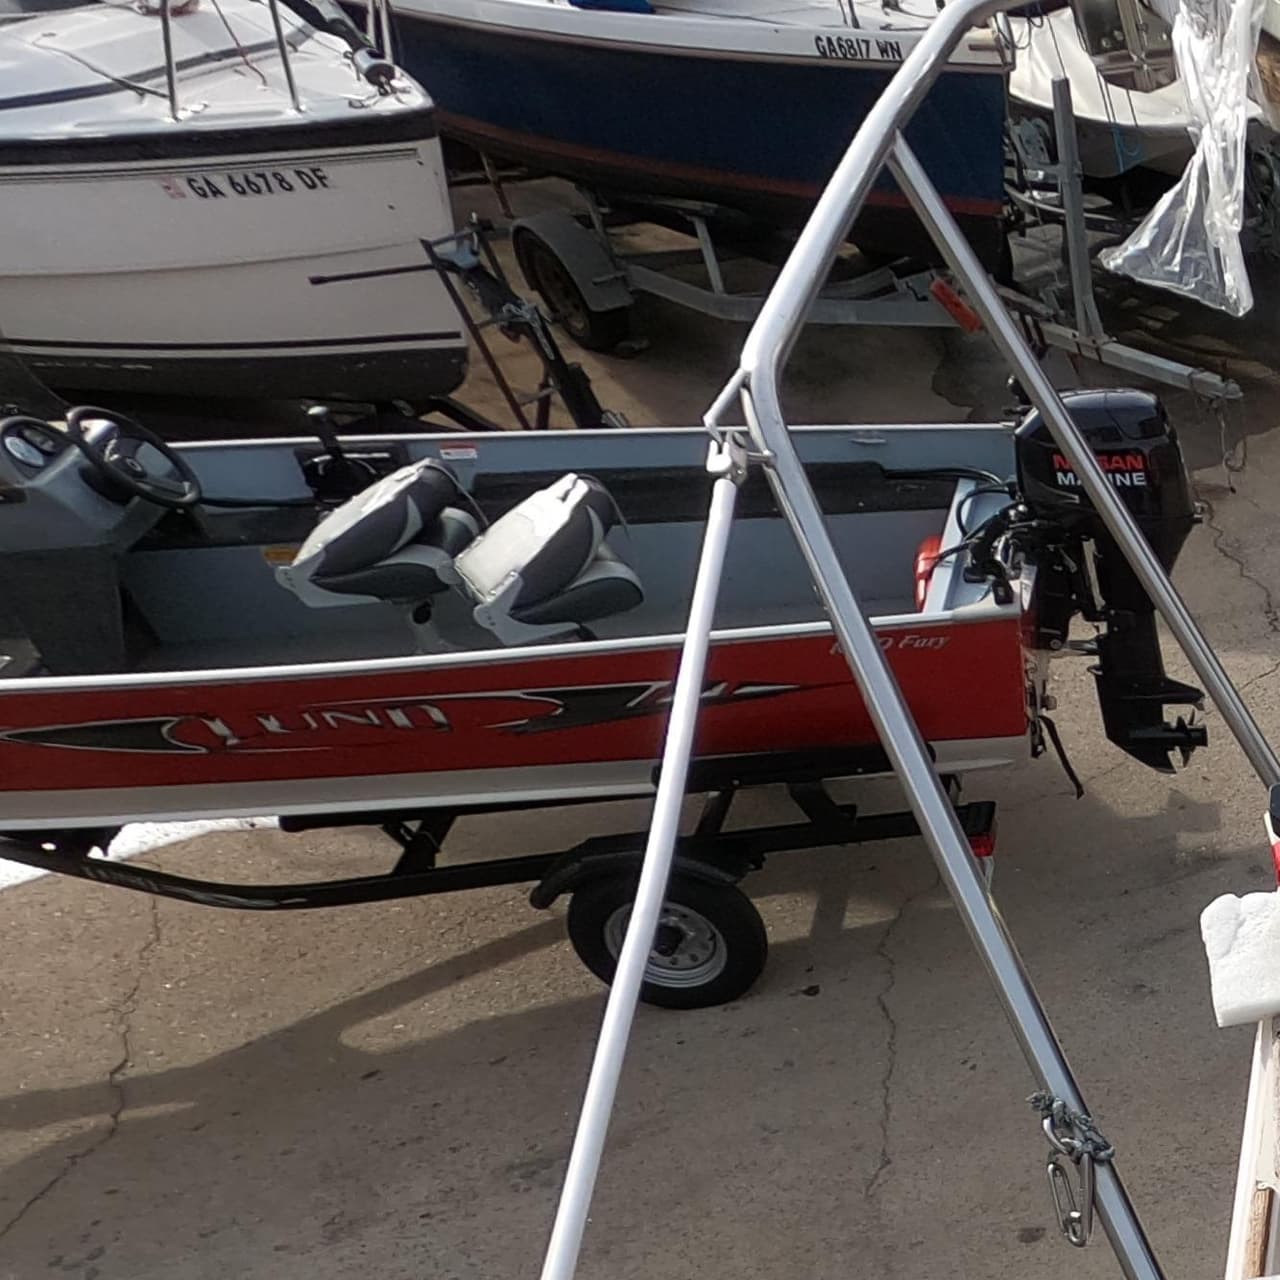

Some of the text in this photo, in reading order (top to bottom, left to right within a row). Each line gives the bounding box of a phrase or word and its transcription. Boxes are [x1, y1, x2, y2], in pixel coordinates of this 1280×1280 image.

[186, 167, 329, 198] GA 6678 DF
[898, 635, 949, 649] Fury
[201, 704, 451, 746] LUND
